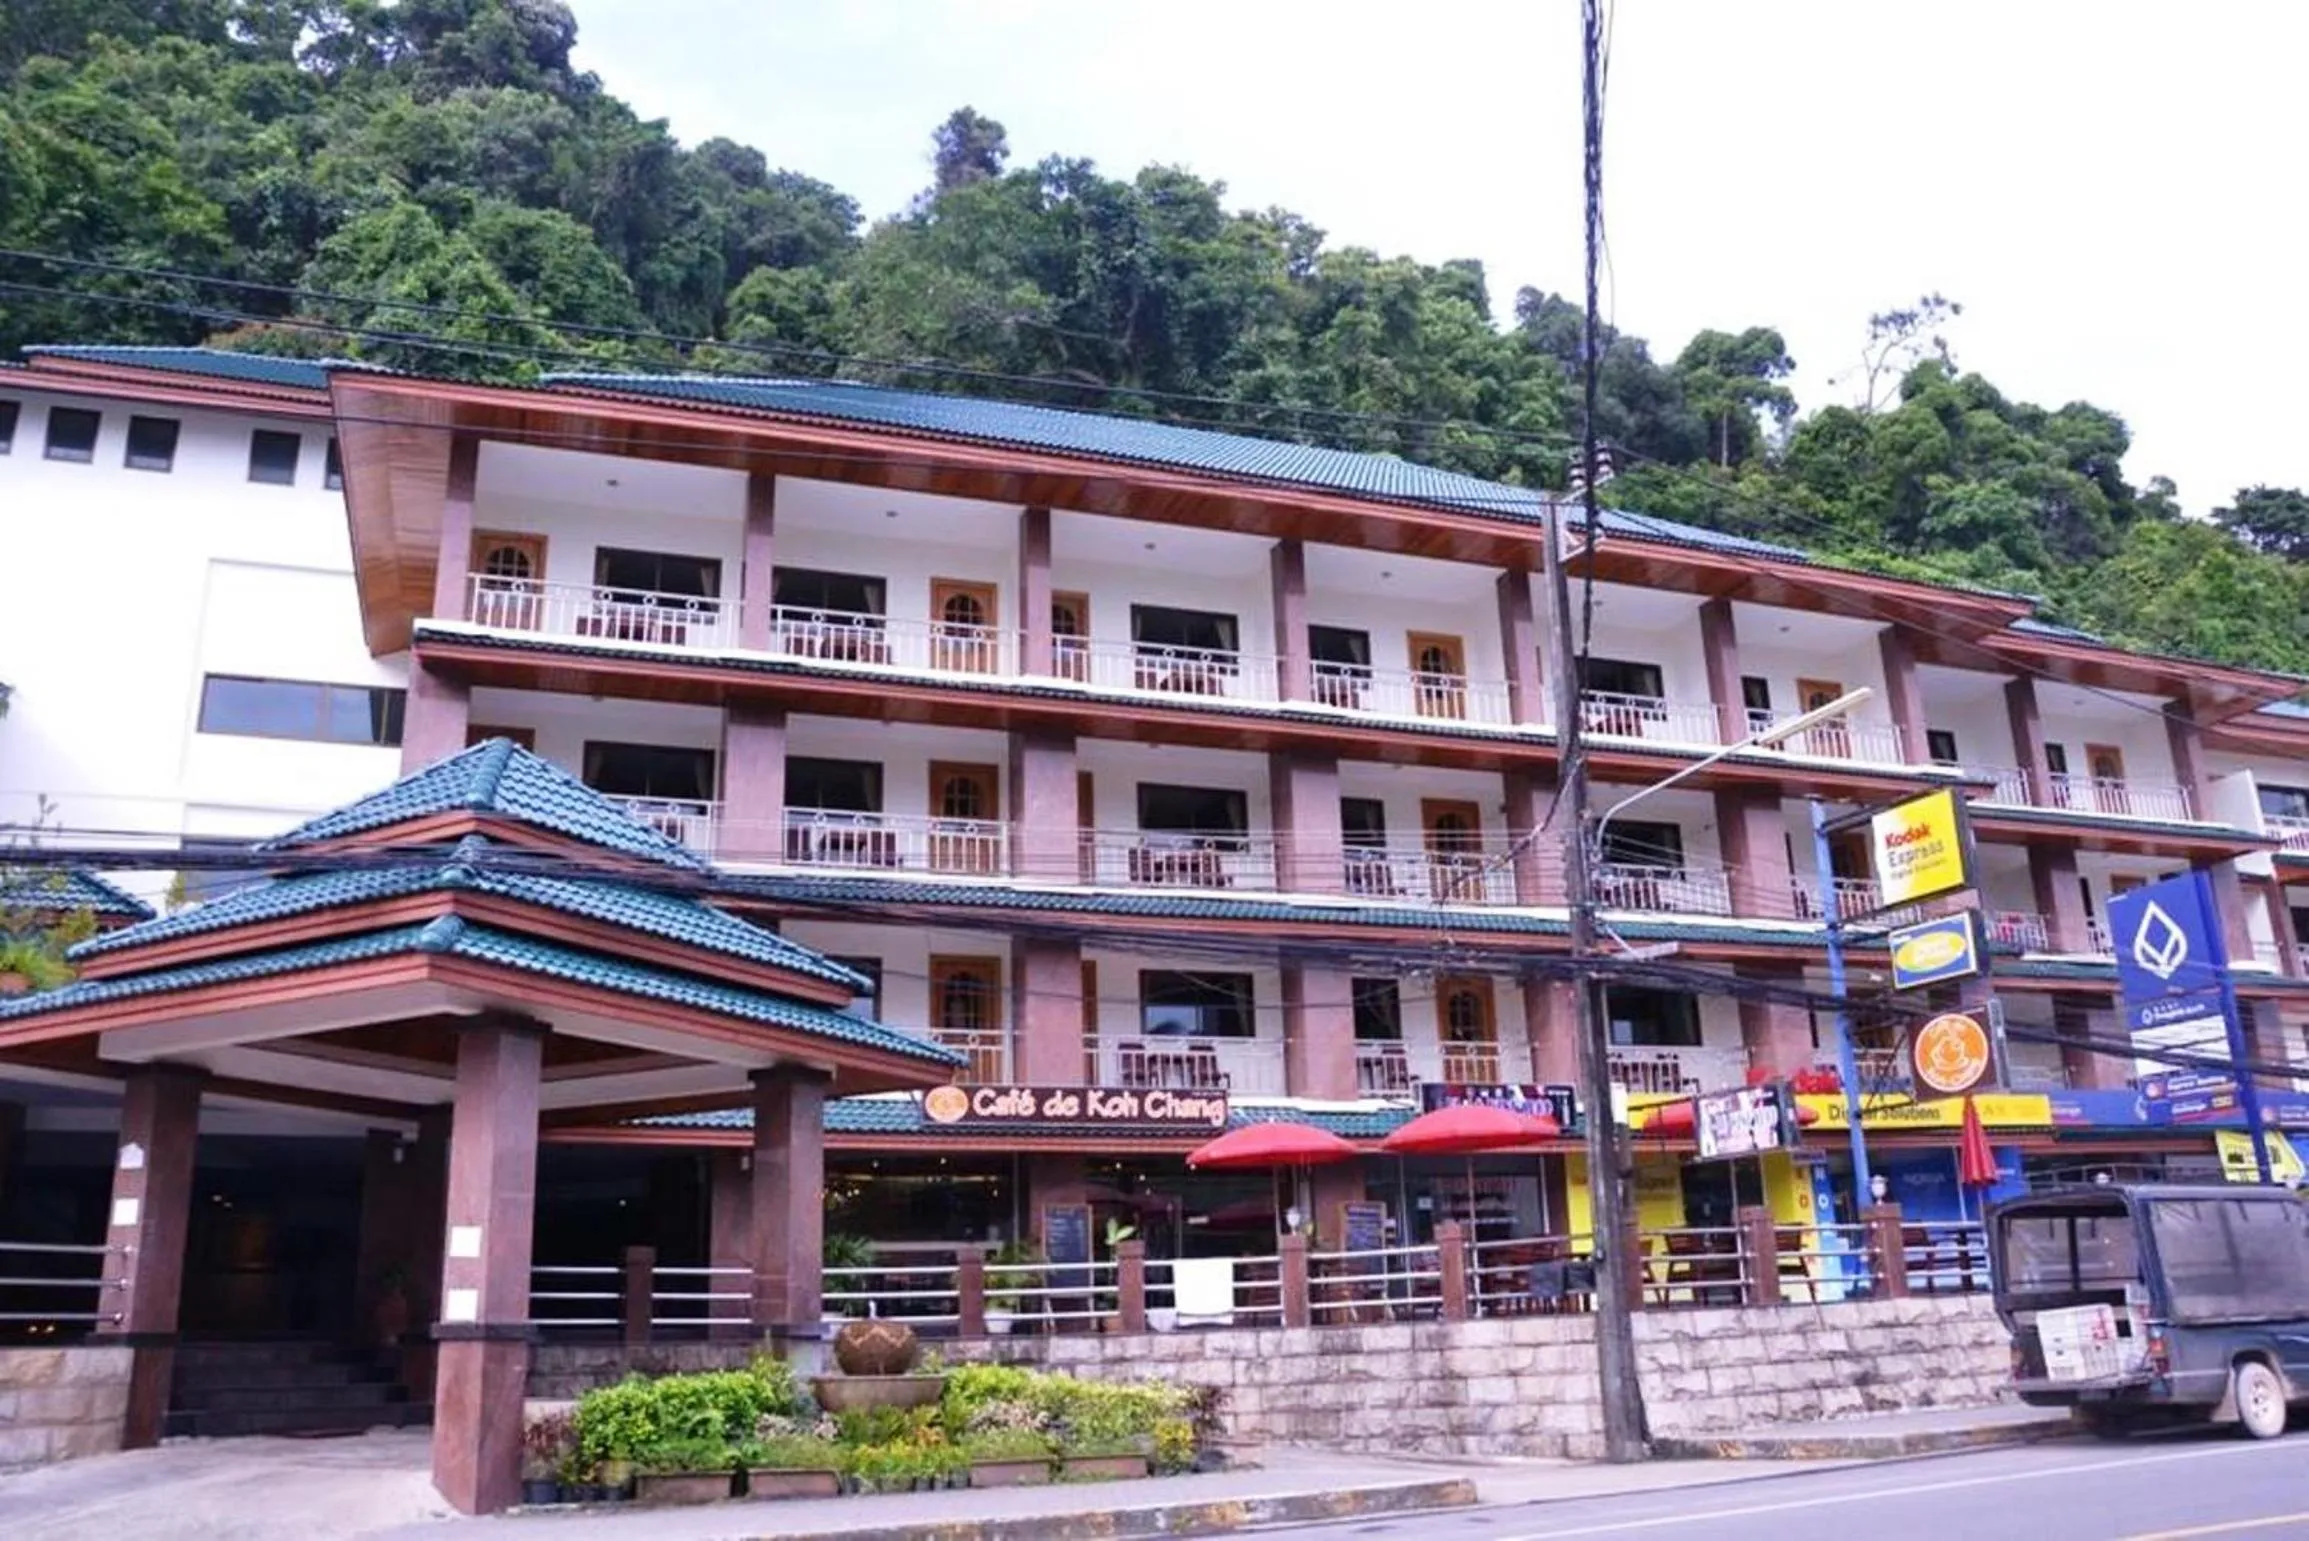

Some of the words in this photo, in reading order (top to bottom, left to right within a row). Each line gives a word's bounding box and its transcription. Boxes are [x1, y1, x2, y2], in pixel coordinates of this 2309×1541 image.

[1885, 823, 1931, 848] Kodak
[1887, 840, 1945, 868] Express
[973, 1088, 1036, 1118] Café
[1042, 1089, 1080, 1118] de
[1086, 1089, 1139, 1119] Koh
[1144, 1090, 1226, 1127] Chang
